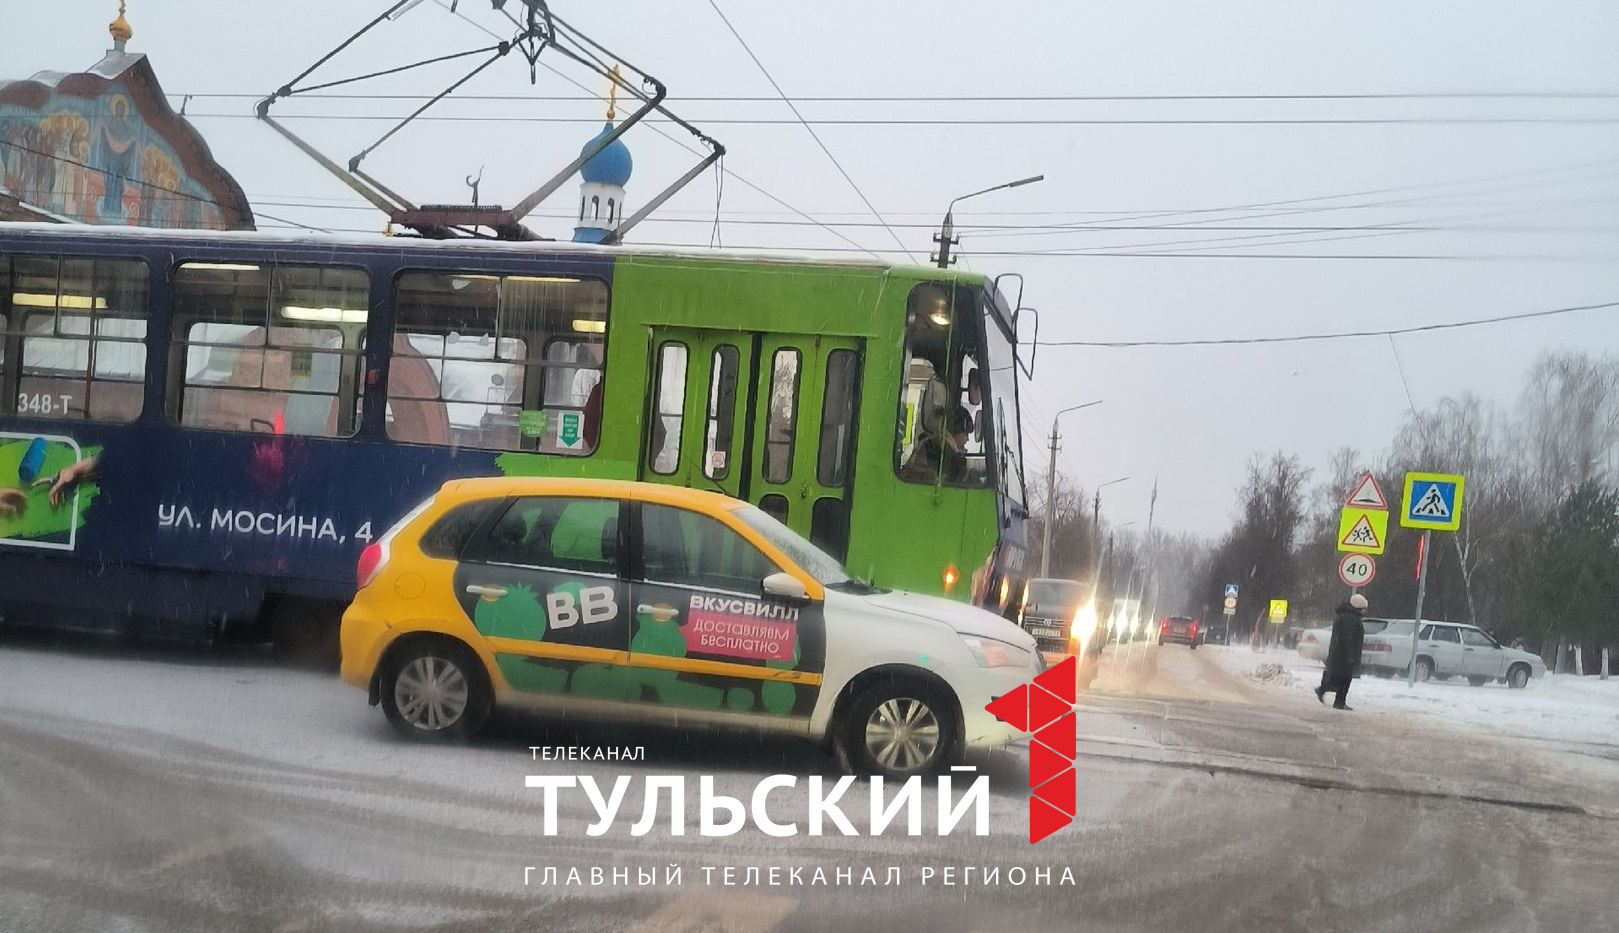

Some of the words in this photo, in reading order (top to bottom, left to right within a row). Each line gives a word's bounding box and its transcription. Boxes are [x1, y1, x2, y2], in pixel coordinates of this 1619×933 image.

[158, 504, 202, 529] УЛ.
[210, 508, 346, 544] МОСИНА,
[354, 521, 373, 543] 4
[1346, 562, 1368, 577] 40
[690, 595, 799, 621] ВКУСВИЛЛ
